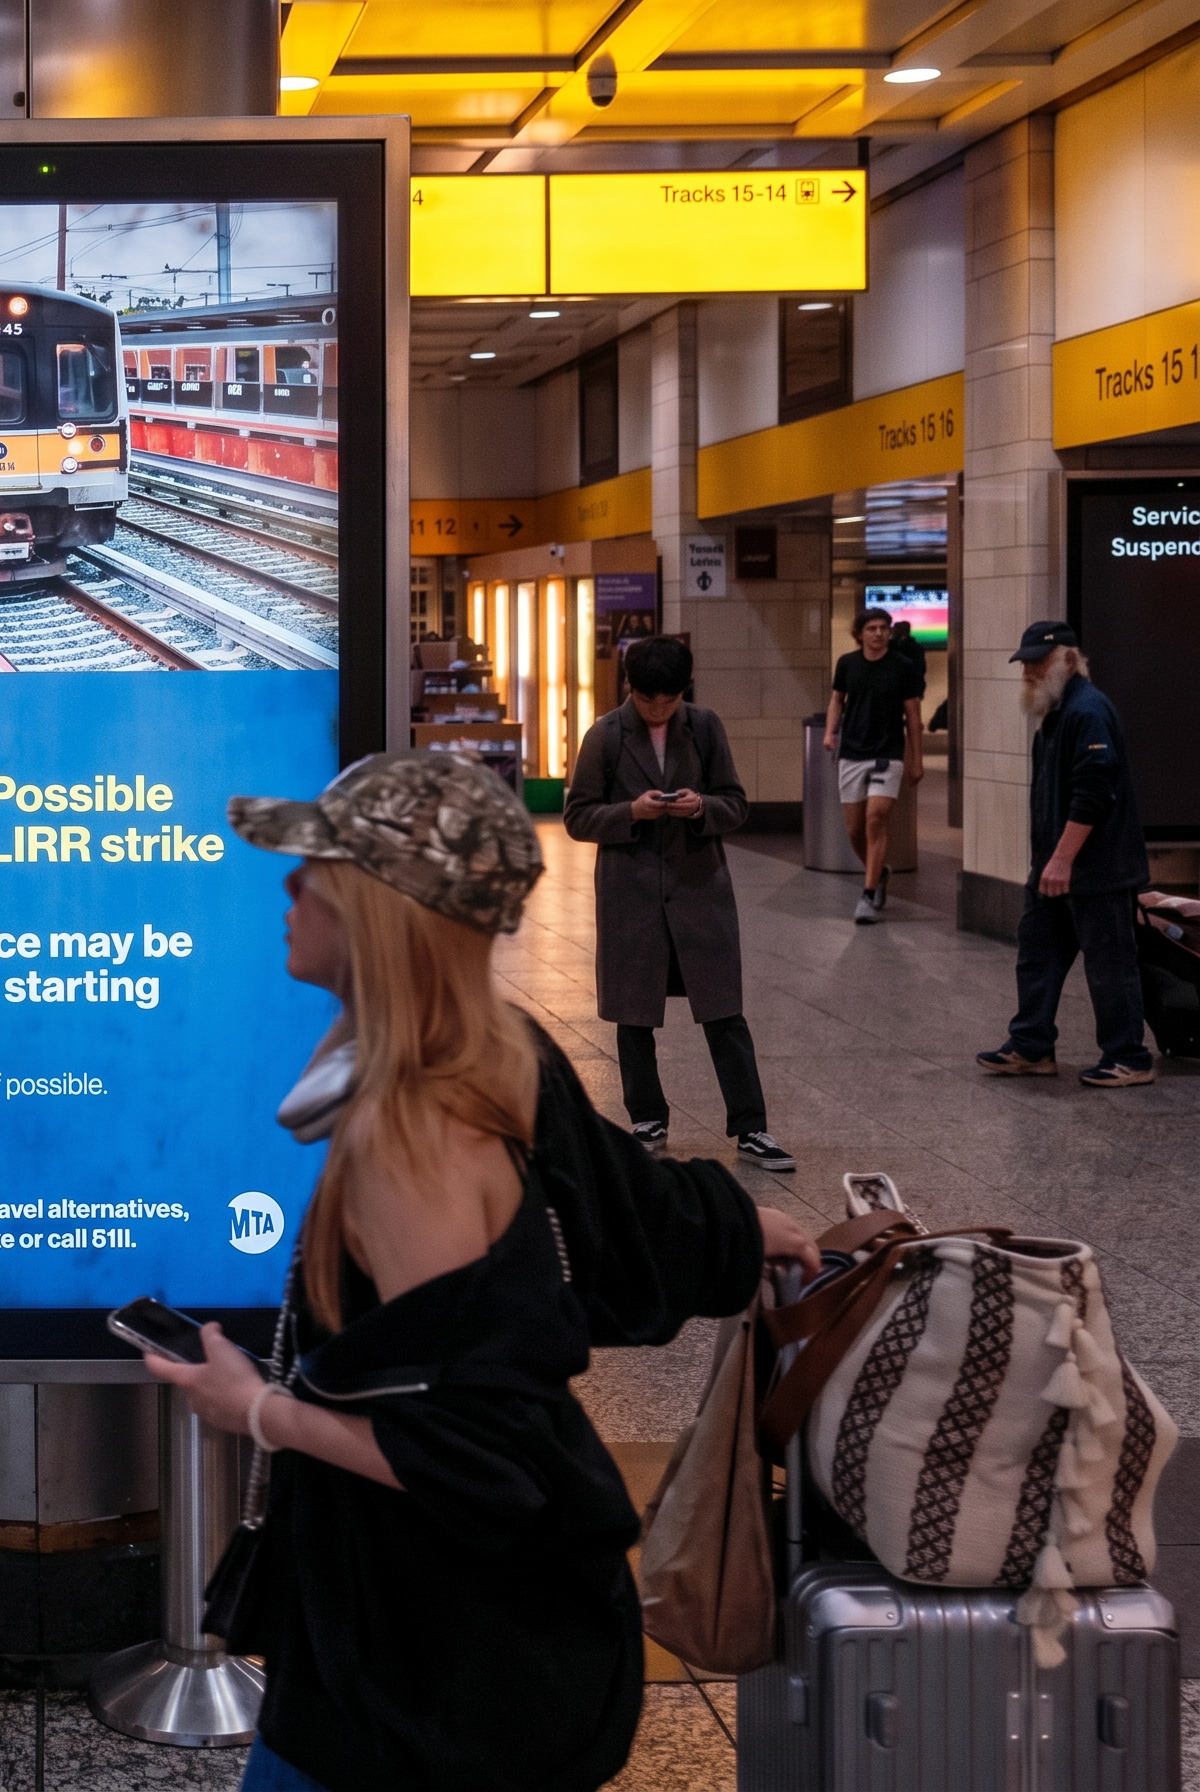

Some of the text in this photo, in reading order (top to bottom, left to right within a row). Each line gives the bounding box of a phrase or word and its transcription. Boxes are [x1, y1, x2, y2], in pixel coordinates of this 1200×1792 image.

[660, 184, 787, 203] Tracks 15-14
[1095, 359, 1154, 401] Tracks
[1162, 347, 1183, 386] 15
[879, 407, 954, 451] Tracks 15 16
[435, 518, 456, 535] 12
[1132, 506, 1200, 526] Servic
[101, 825, 224, 862] strike
[50, 933, 134, 964] may
[144, 924, 192, 957] be
[5, 969, 159, 1009] starting
[7, 1073, 107, 1099] possible.
[48, 1199, 189, 1221] alternatives,
[228, 1206, 275, 1240] MTA
[19, 1234, 44, 1248] or
[48, 1229, 87, 1248] call
